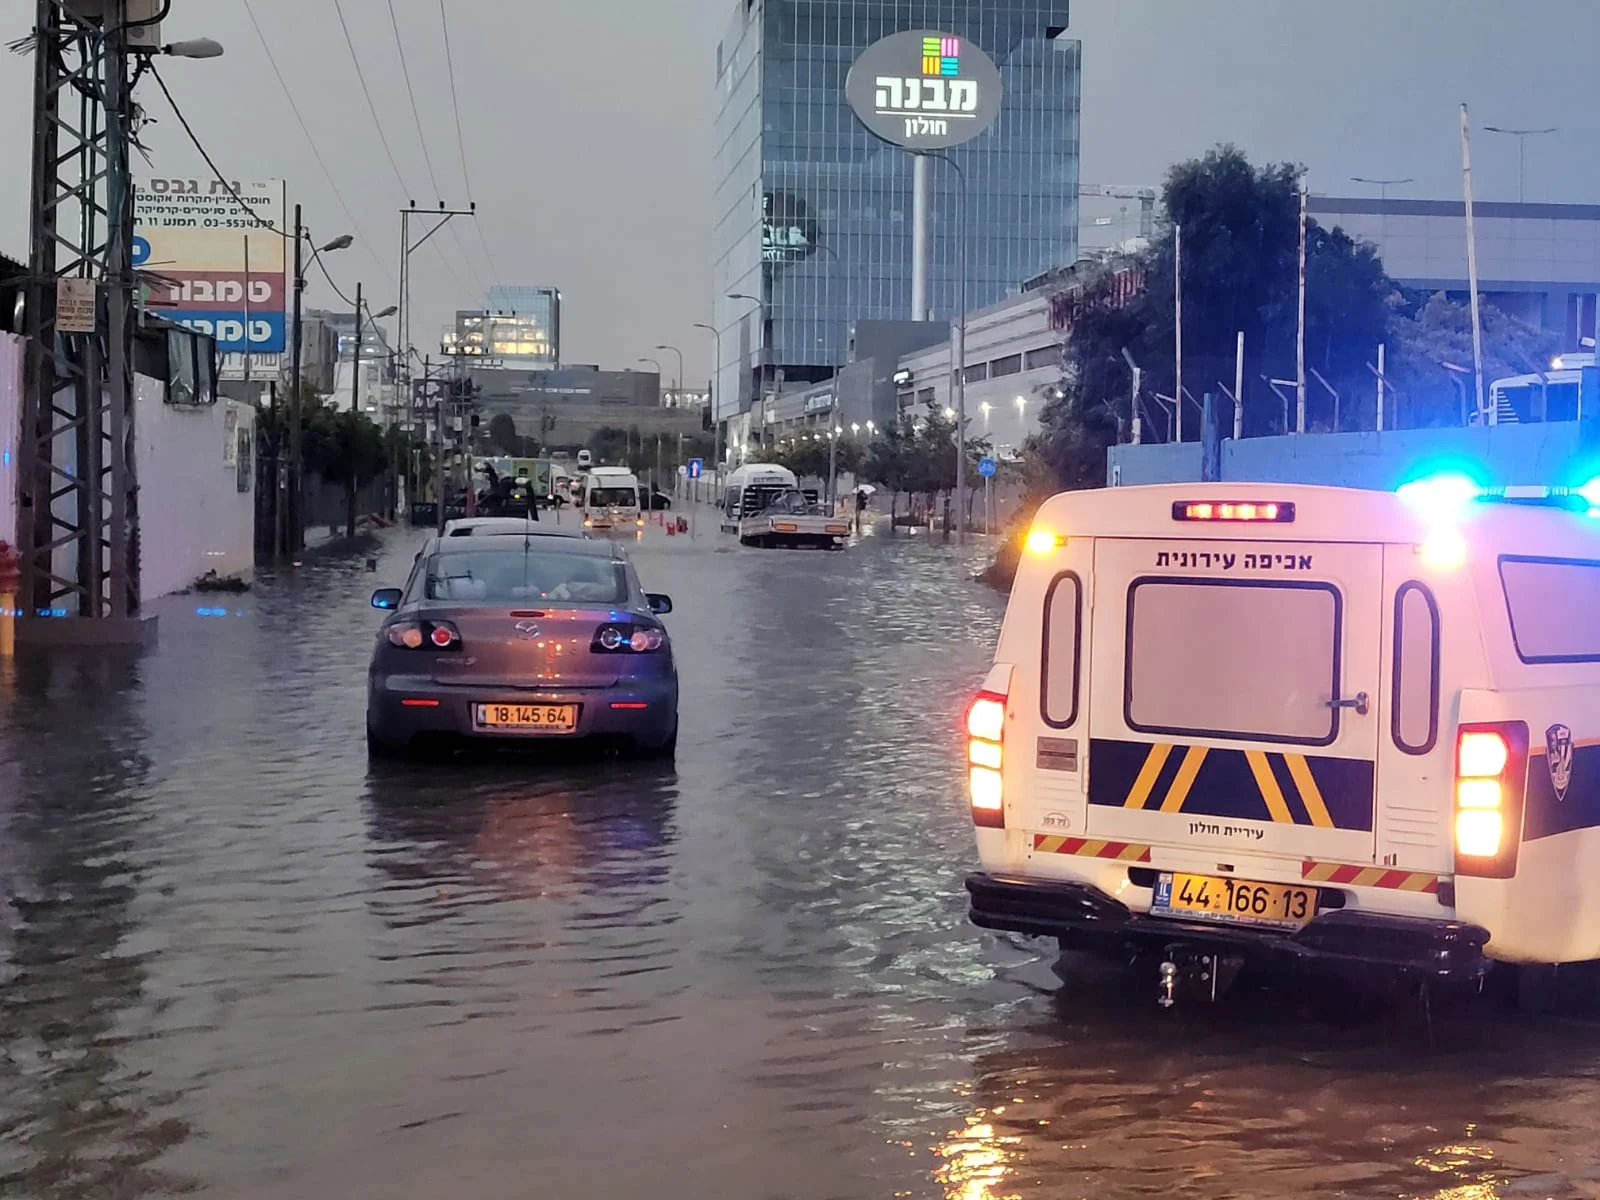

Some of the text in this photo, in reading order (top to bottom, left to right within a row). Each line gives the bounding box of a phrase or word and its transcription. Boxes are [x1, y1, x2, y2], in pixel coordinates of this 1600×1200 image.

[875, 76, 978, 111] מבנה
[904, 116, 947, 138] חולון
[150, 179, 198, 194] גבס
[209, 180, 241, 195] גת
[163, 218, 197, 226] תמנע
[1155, 551, 1313, 570] אכיפה עירונית
[1189, 821, 1264, 840] עיריית חולון
